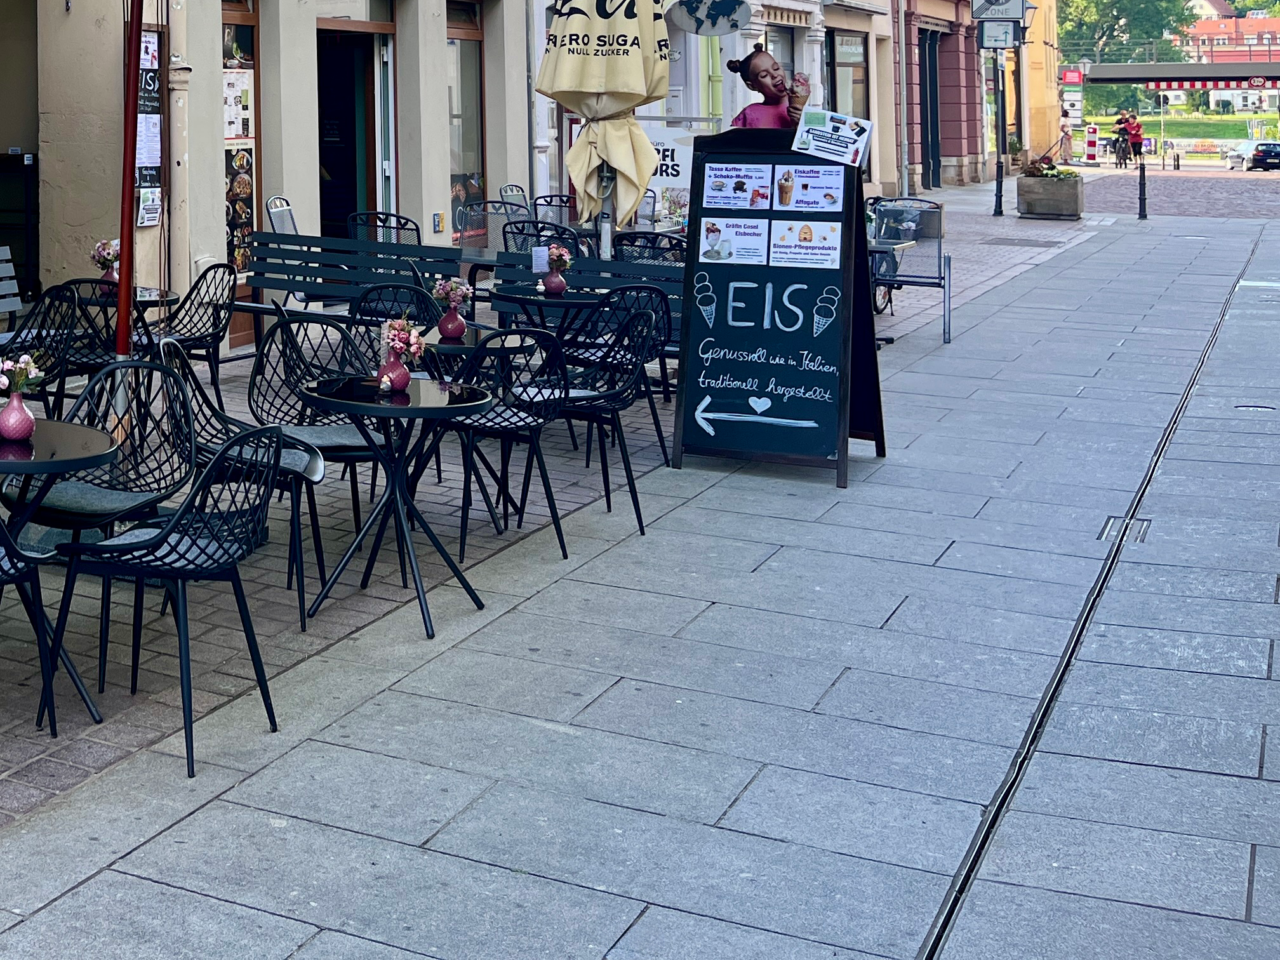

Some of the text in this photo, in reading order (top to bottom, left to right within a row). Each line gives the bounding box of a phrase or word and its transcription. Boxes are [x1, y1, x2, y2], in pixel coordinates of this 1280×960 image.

[985, 8, 1010, 16] ZONE
[568, 48, 630, 57] NULL ZUCKER
[727, 282, 808, 332] EIS
[770, 354, 785, 364] wie
[788, 356, 796, 365] in
[797, 351, 839, 376] Italien,
[698, 370, 833, 402] traditionell hergestellt
